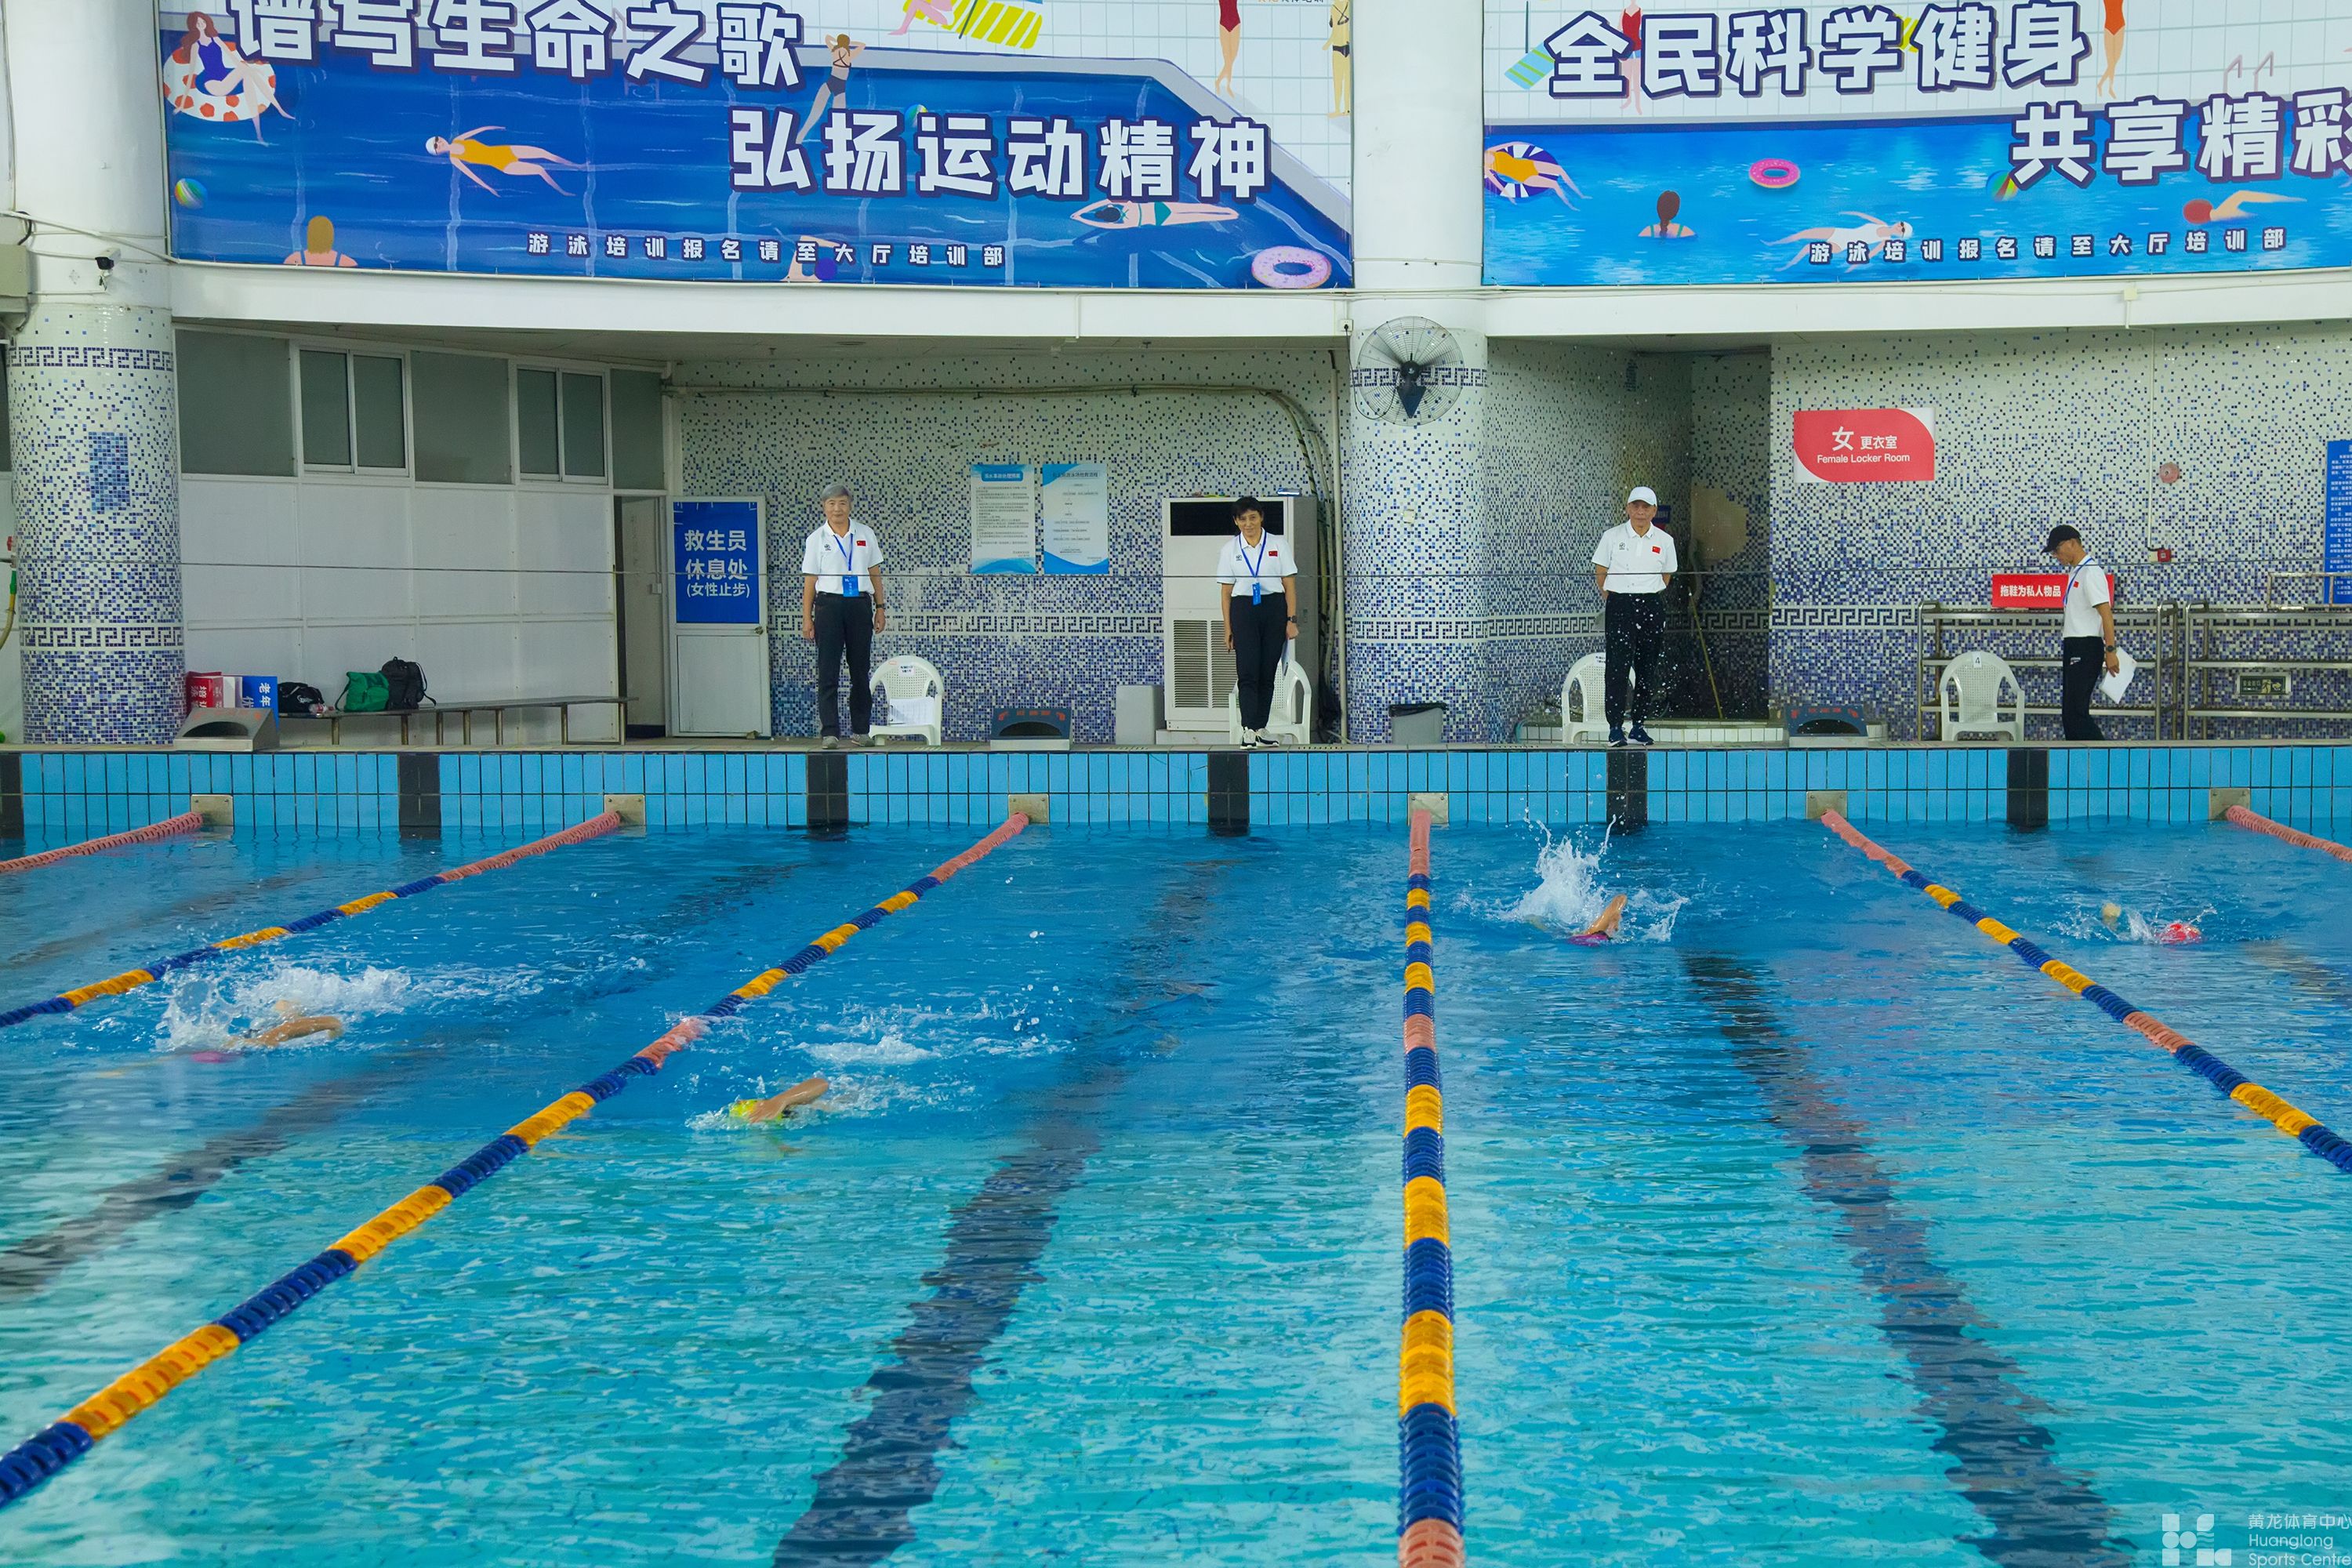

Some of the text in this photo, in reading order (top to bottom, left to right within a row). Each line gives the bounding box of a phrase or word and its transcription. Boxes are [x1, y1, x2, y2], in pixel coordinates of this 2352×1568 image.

[229, 0, 800, 87] 谱写生命之歌
[1548, 3, 2086, 96] 全民科学健身
[2012, 88, 2352, 185] 共享精彩
[731, 110, 1266, 198] 弘扬运动精神
[528, 233, 1005, 267] 游泳培训报名请至大厅培训部
[1809, 227, 2285, 263] 游泳培训报名请至大厅培训部
[1831, 426, 1897, 451] 女 更衣室
[1817, 453, 1910, 463] Female Locker Room
[684, 529, 747, 551] 救生员
[685, 558, 748, 580] 休息处
[687, 582, 750, 598] (女性止步)
[2000, 585, 2061, 597] 拖鞋为私人物品
